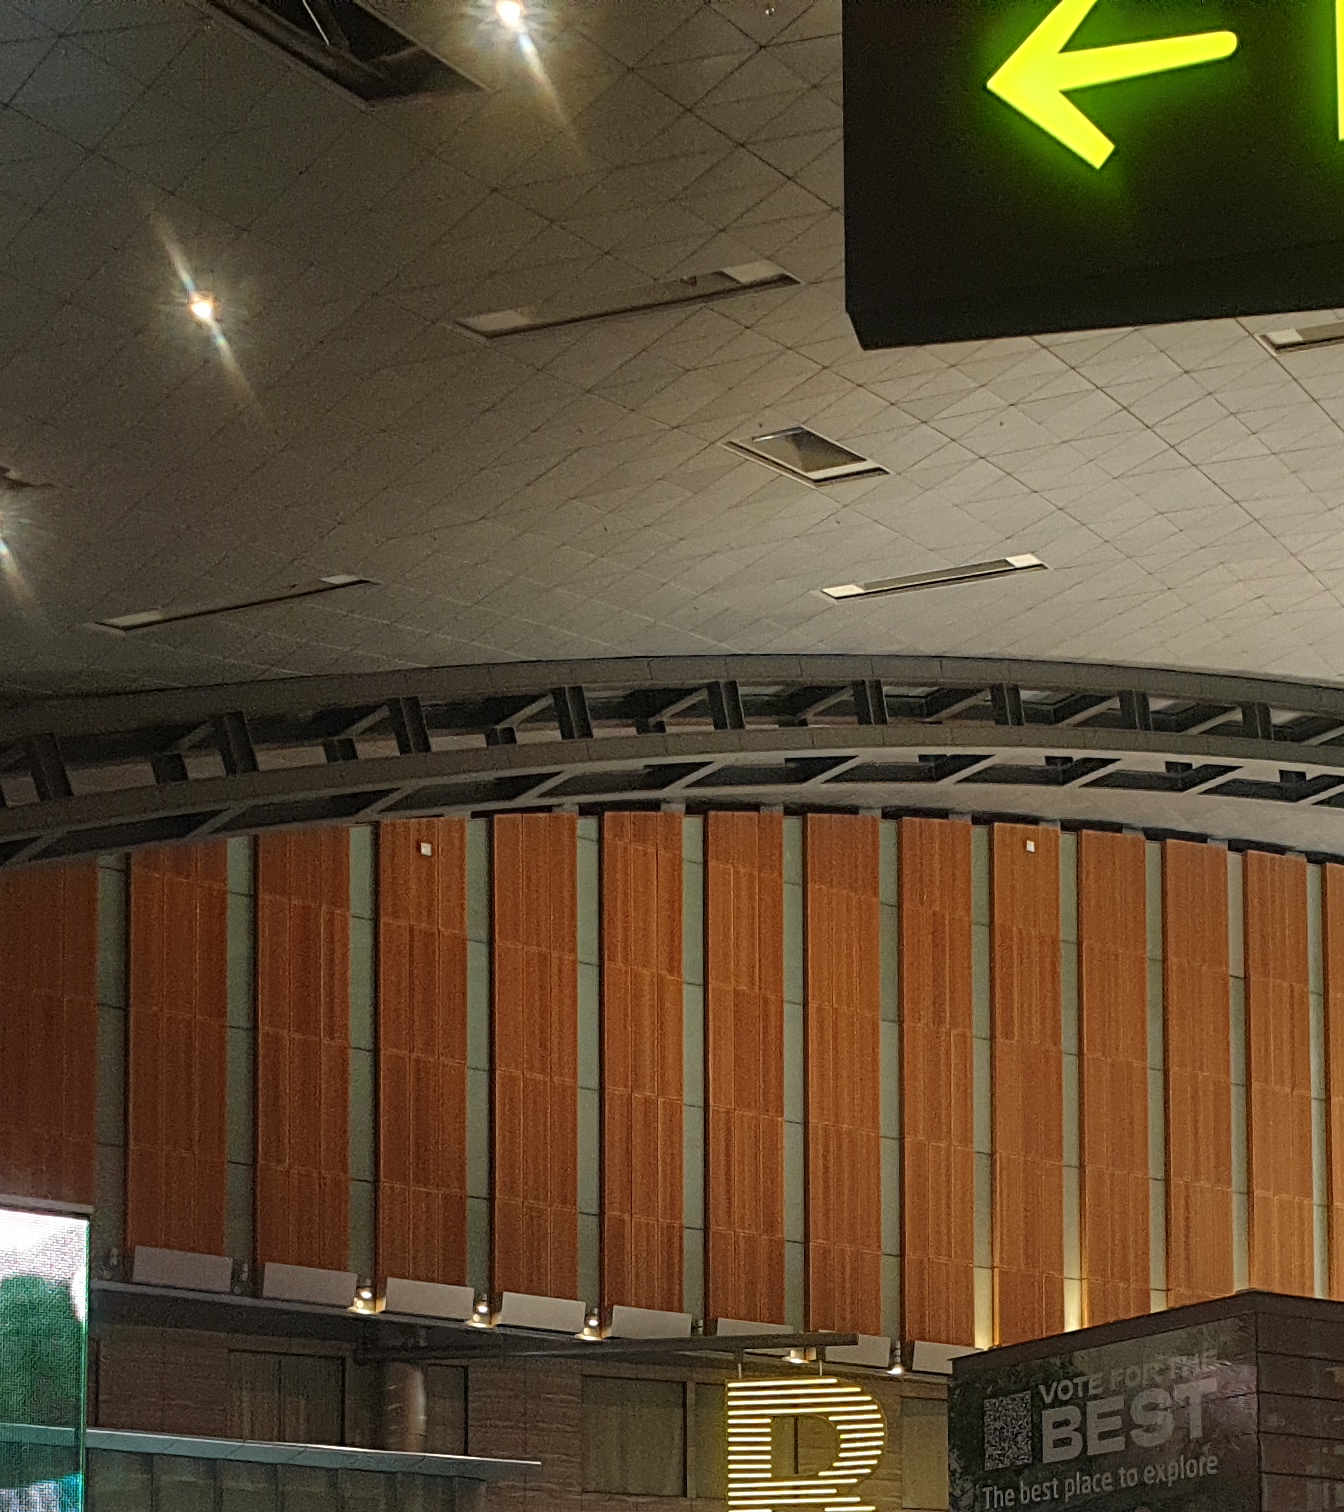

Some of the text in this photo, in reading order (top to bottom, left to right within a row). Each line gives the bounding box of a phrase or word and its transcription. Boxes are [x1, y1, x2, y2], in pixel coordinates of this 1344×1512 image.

[1039, 1374, 1106, 1404] VOTE
[1110, 1364, 1163, 1391] FOR
[1041, 1378, 1218, 1464] BEST
[982, 1454, 1219, 1509] The best place to explore
